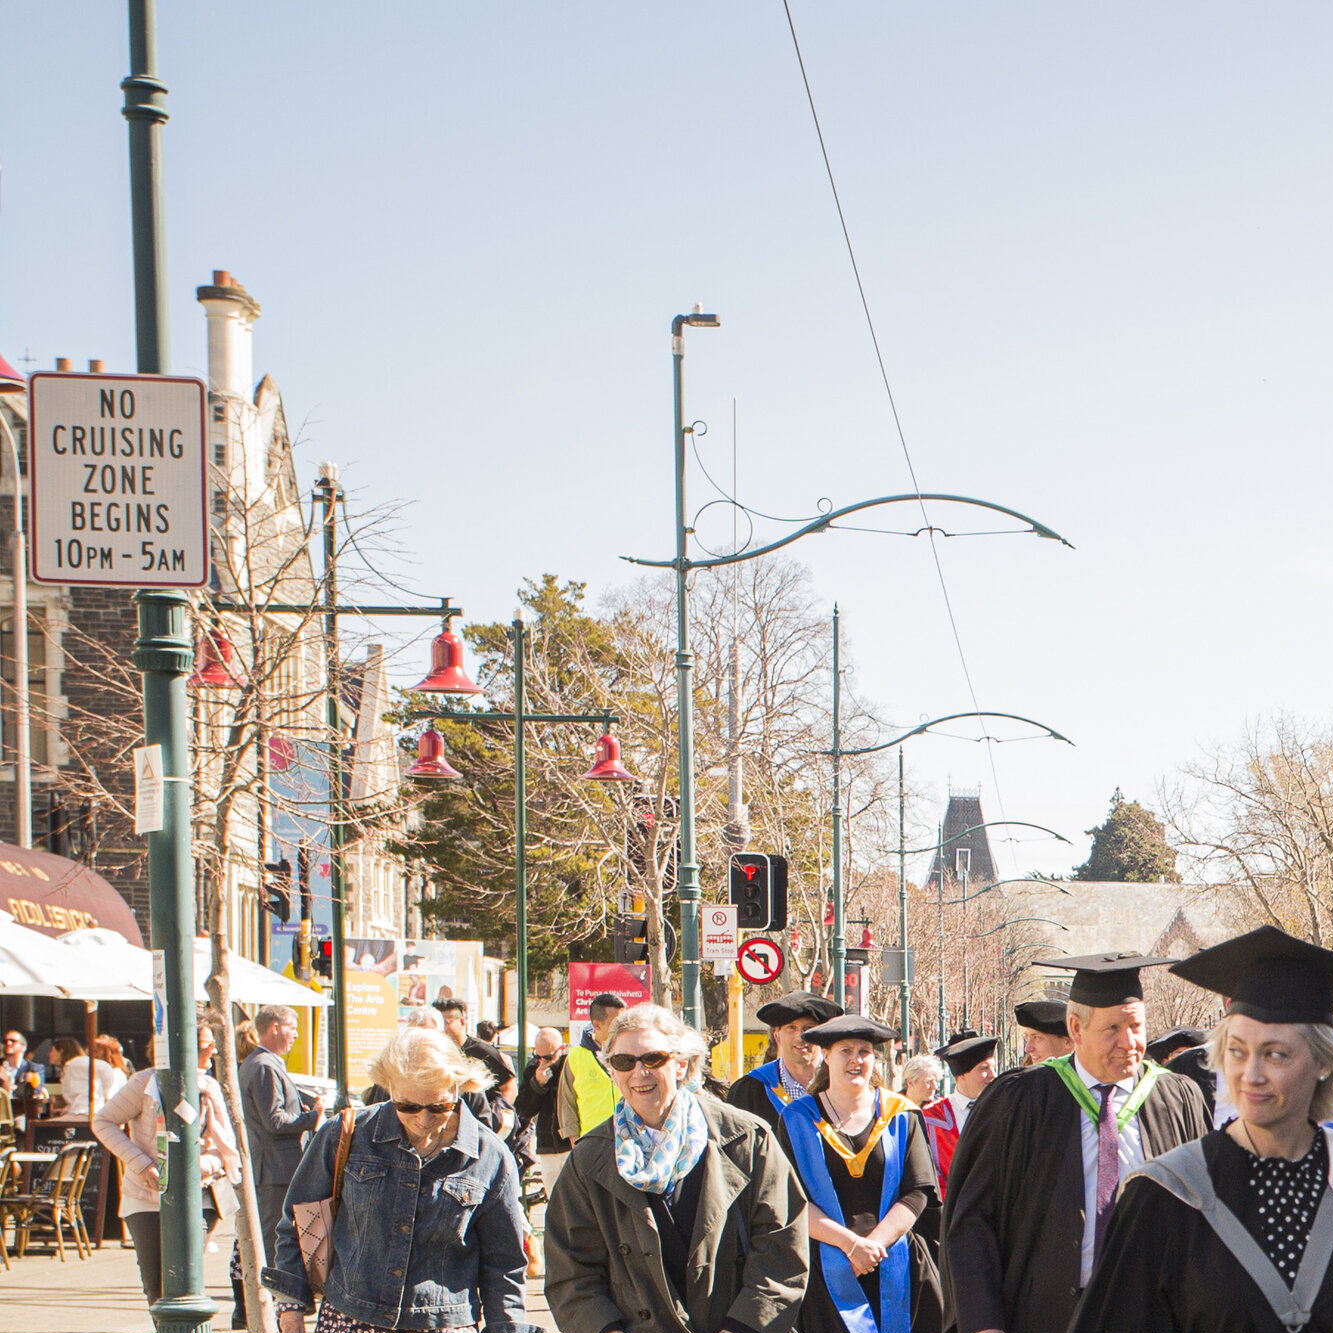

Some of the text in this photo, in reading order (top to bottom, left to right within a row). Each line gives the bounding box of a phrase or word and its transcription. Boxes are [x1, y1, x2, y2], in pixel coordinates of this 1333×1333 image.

[100, 389, 135, 419] NO
[53, 425, 184, 459] CRUISING
[84, 464, 155, 495] ZONE
[72, 501, 169, 534] BEGINS
[55, 539, 113, 570] 10PM
[141, 541, 185, 572] 5AM
[346, 982, 380, 993] Explore
[346, 993, 384, 1004] The Arts
[346, 1005, 377, 1015] Centre
